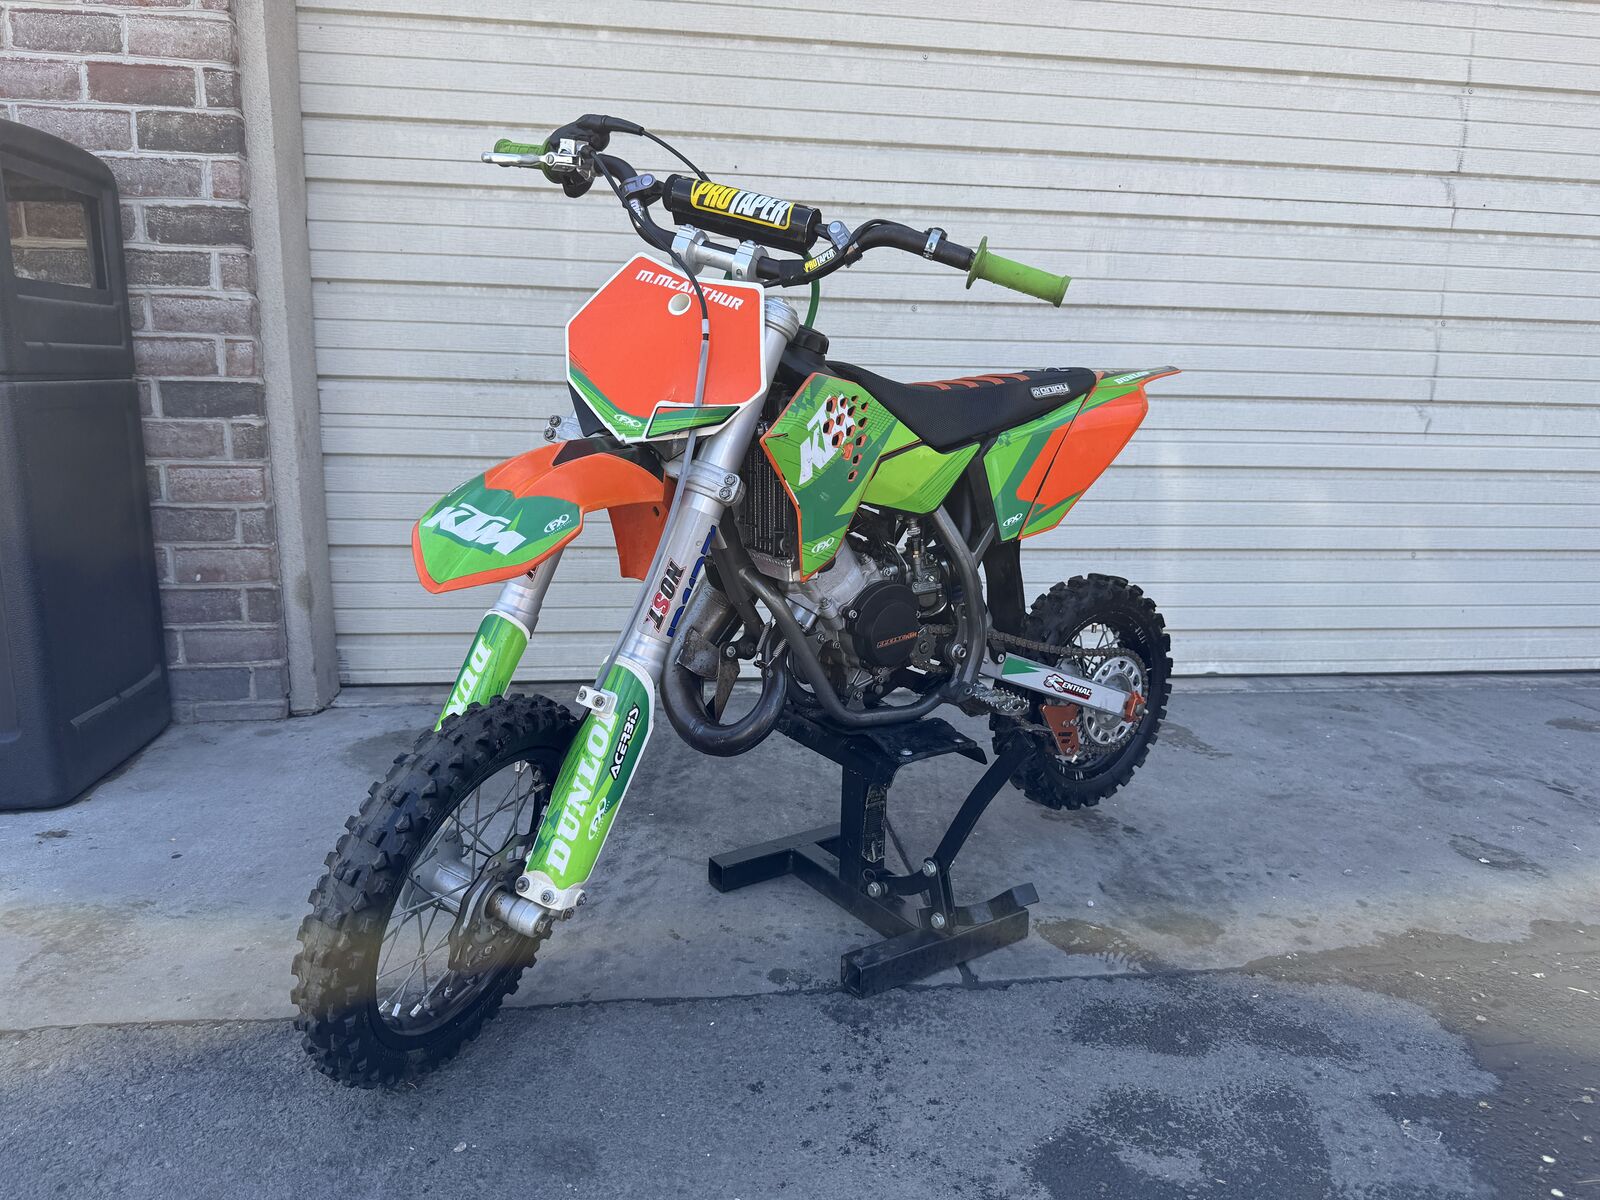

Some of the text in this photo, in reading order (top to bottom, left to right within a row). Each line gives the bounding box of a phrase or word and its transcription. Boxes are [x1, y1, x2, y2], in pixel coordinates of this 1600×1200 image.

[692, 181, 792, 226] PROTAPER
[803, 249, 836, 272] PROTAPER
[422, 502, 527, 556] KTM
